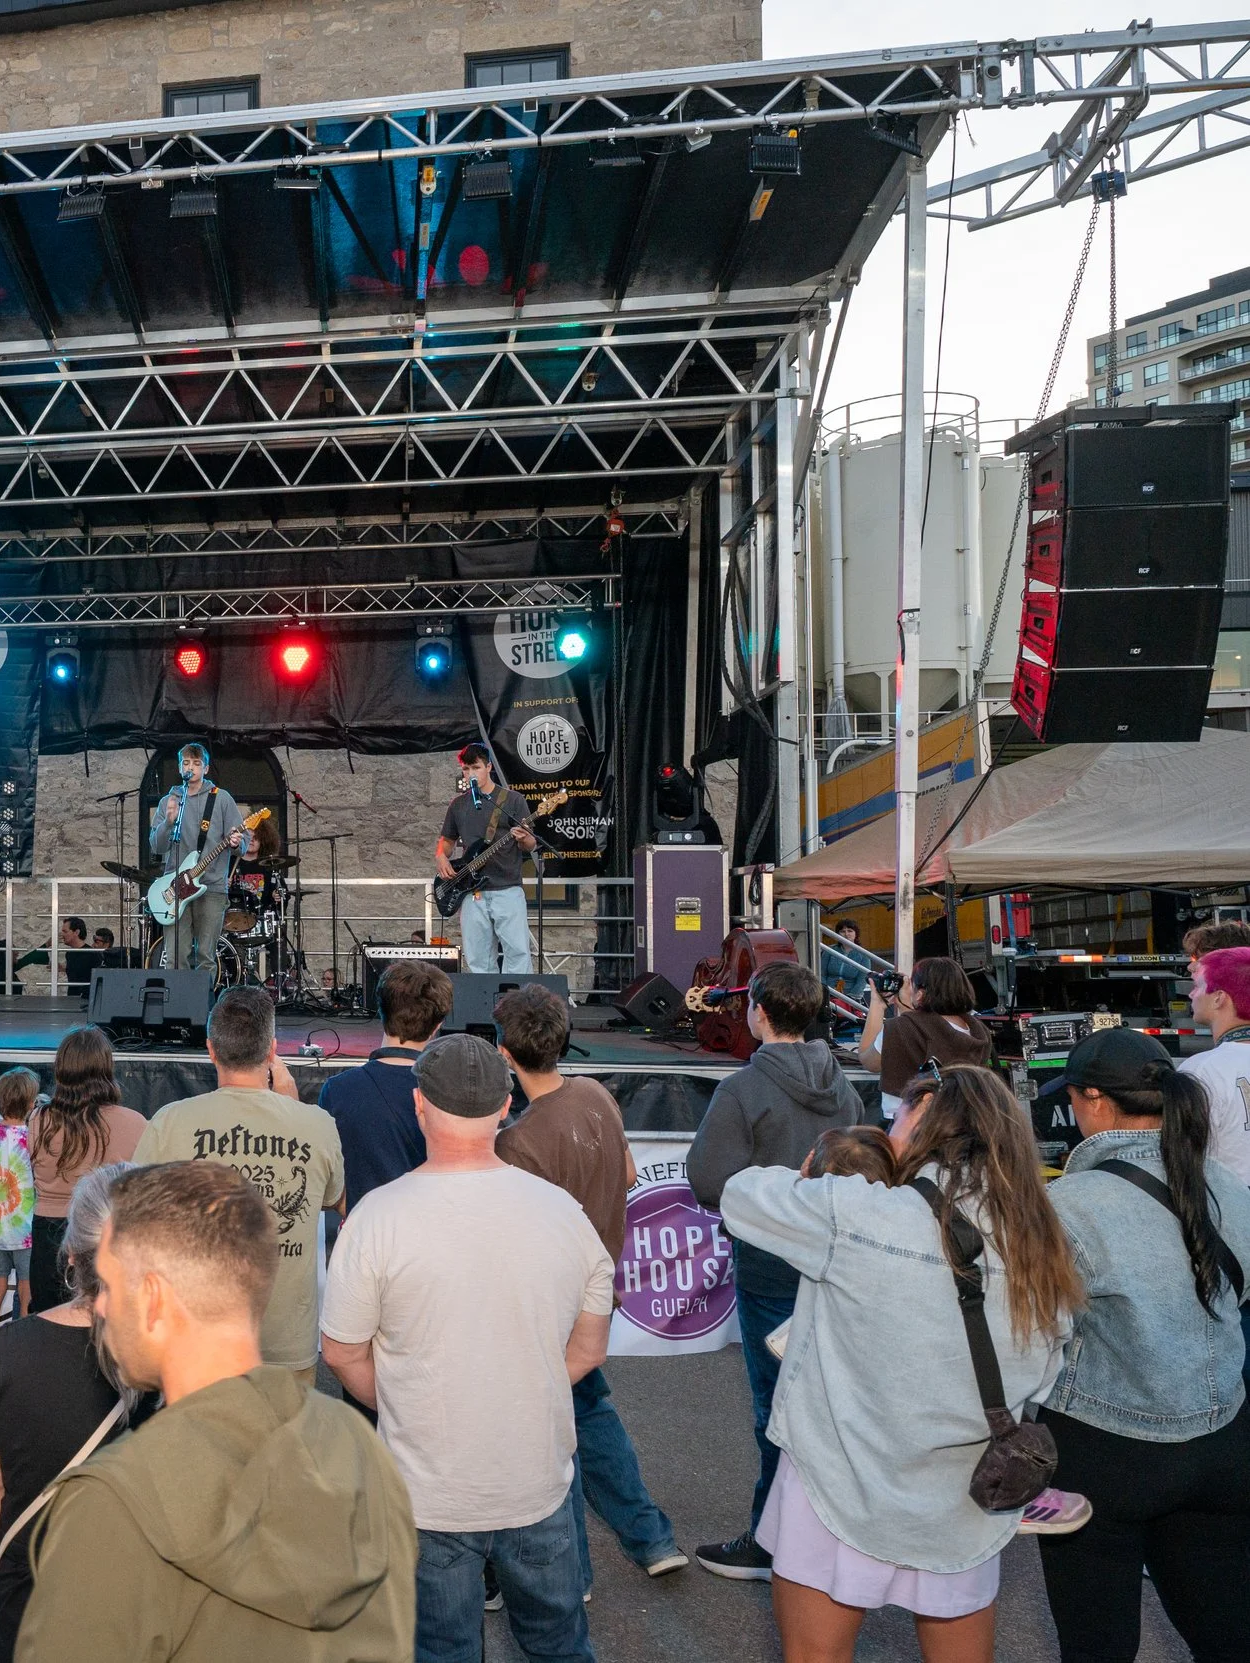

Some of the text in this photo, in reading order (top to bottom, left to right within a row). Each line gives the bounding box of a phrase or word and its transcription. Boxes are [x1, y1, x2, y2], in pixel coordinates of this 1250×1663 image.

[528, 633, 538, 641] IN
[524, 698, 563, 708] SUPPORT
[530, 729, 564, 744] HOPE
[526, 741, 570, 756] HOUSE
[535, 756, 561, 766] GUELPH
[538, 781, 559, 789] YOU
[547, 817, 578, 828] JOHN
[193, 1124, 312, 1164] Deftones
[633, 1223, 730, 1260] HOPE
[623, 1257, 735, 1293] HOUSE
[651, 1295, 709, 1318] GUELPH
